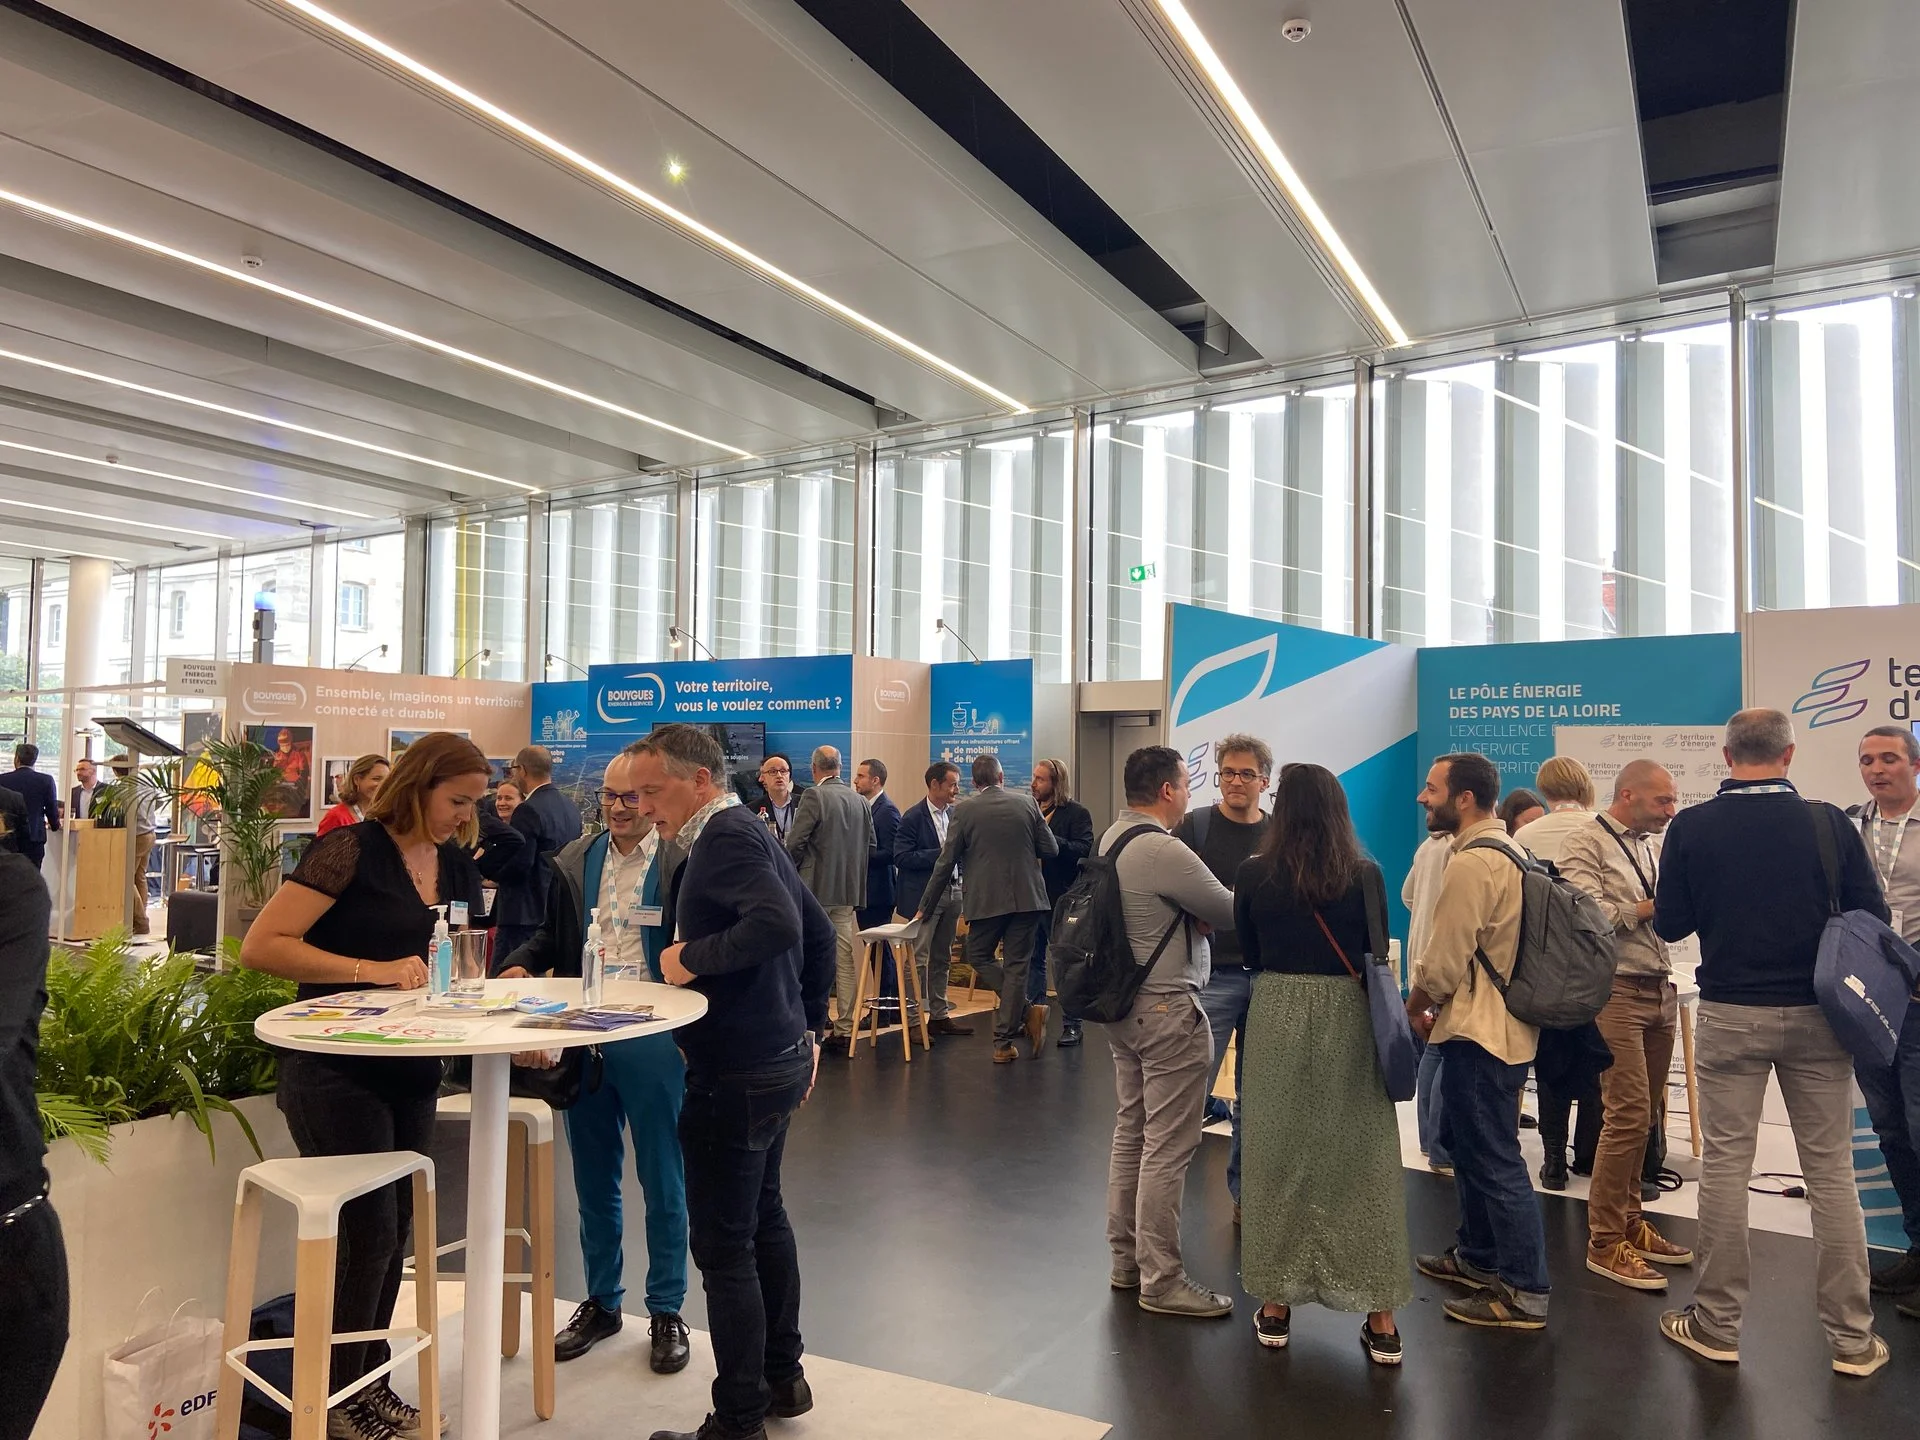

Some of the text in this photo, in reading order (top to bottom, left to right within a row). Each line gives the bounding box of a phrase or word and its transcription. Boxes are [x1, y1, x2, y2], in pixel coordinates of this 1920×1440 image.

[189, 678, 217, 686] SERVICES
[675, 678, 773, 693] Votre territoire,
[253, 691, 297, 701] BOUYGUES
[315, 685, 525, 708] Ensemble, imaginons un territoire
[607, 689, 654, 701] BOUYGUES
[1449, 682, 1582, 700] LE PÔLE ÉNERGIE
[674, 696, 842, 712] vous le voulez comment ?
[1449, 703, 1621, 719] DES PAYS DE LA LOIRE
[315, 703, 446, 720] connecté et durable
[1449, 724, 1547, 737] L'EXCELLENCE
[953, 745, 999, 754] de mobilité
[1472, 742, 1530, 756] SERVICE
[953, 755, 964, 763] de
